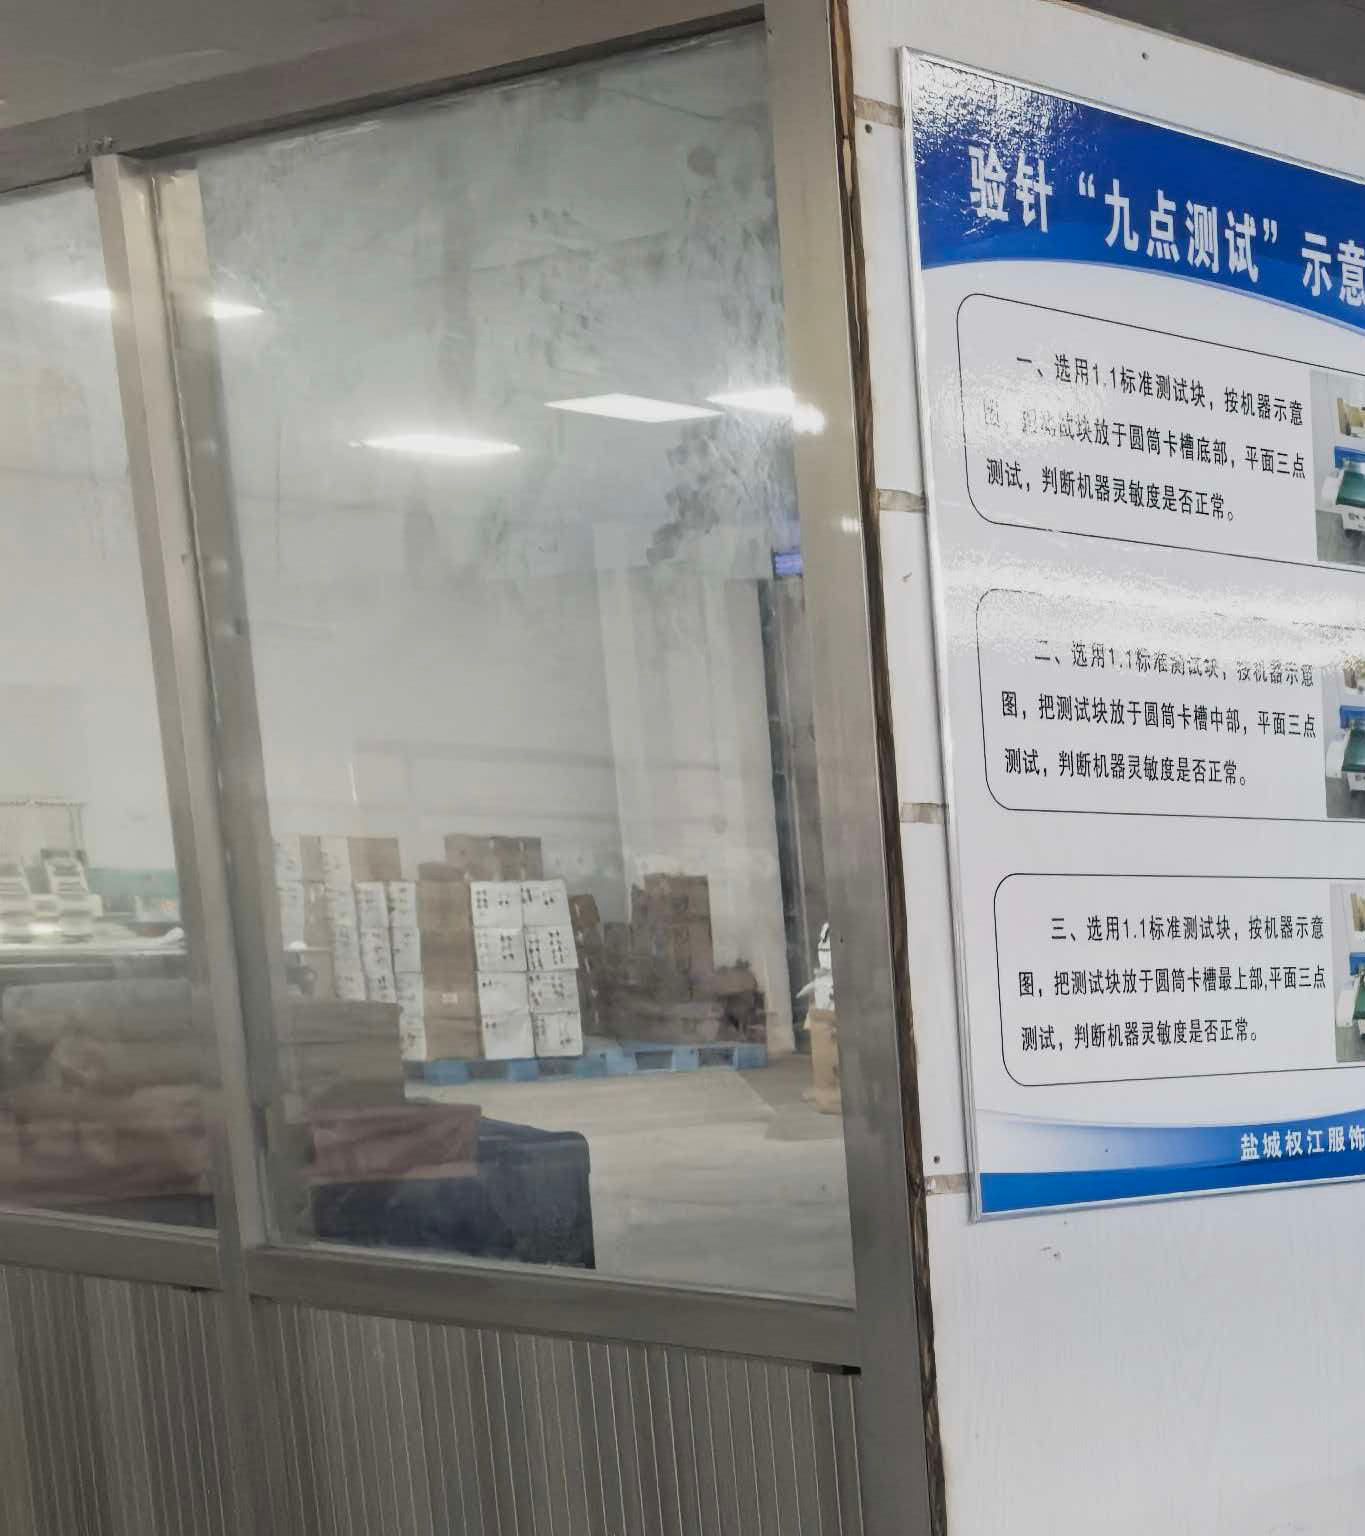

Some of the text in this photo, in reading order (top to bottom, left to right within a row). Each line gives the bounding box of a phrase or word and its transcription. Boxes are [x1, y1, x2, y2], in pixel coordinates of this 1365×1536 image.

[986, 457, 1236, 522] 测试，判断机器灵敏度是否正常。
[1001, 690, 1317, 739] 图，把测试块放于圆筒卡槽中部，平面三点
[1004, 747, 1247, 787] 测试，判断机器灵敏度是否正常。
[1051, 914, 1325, 943] 三、选用1.1标准测试块，按机器示意
[1021, 1018, 1258, 1052] 测试，判断机器灵敏度是否正常。
